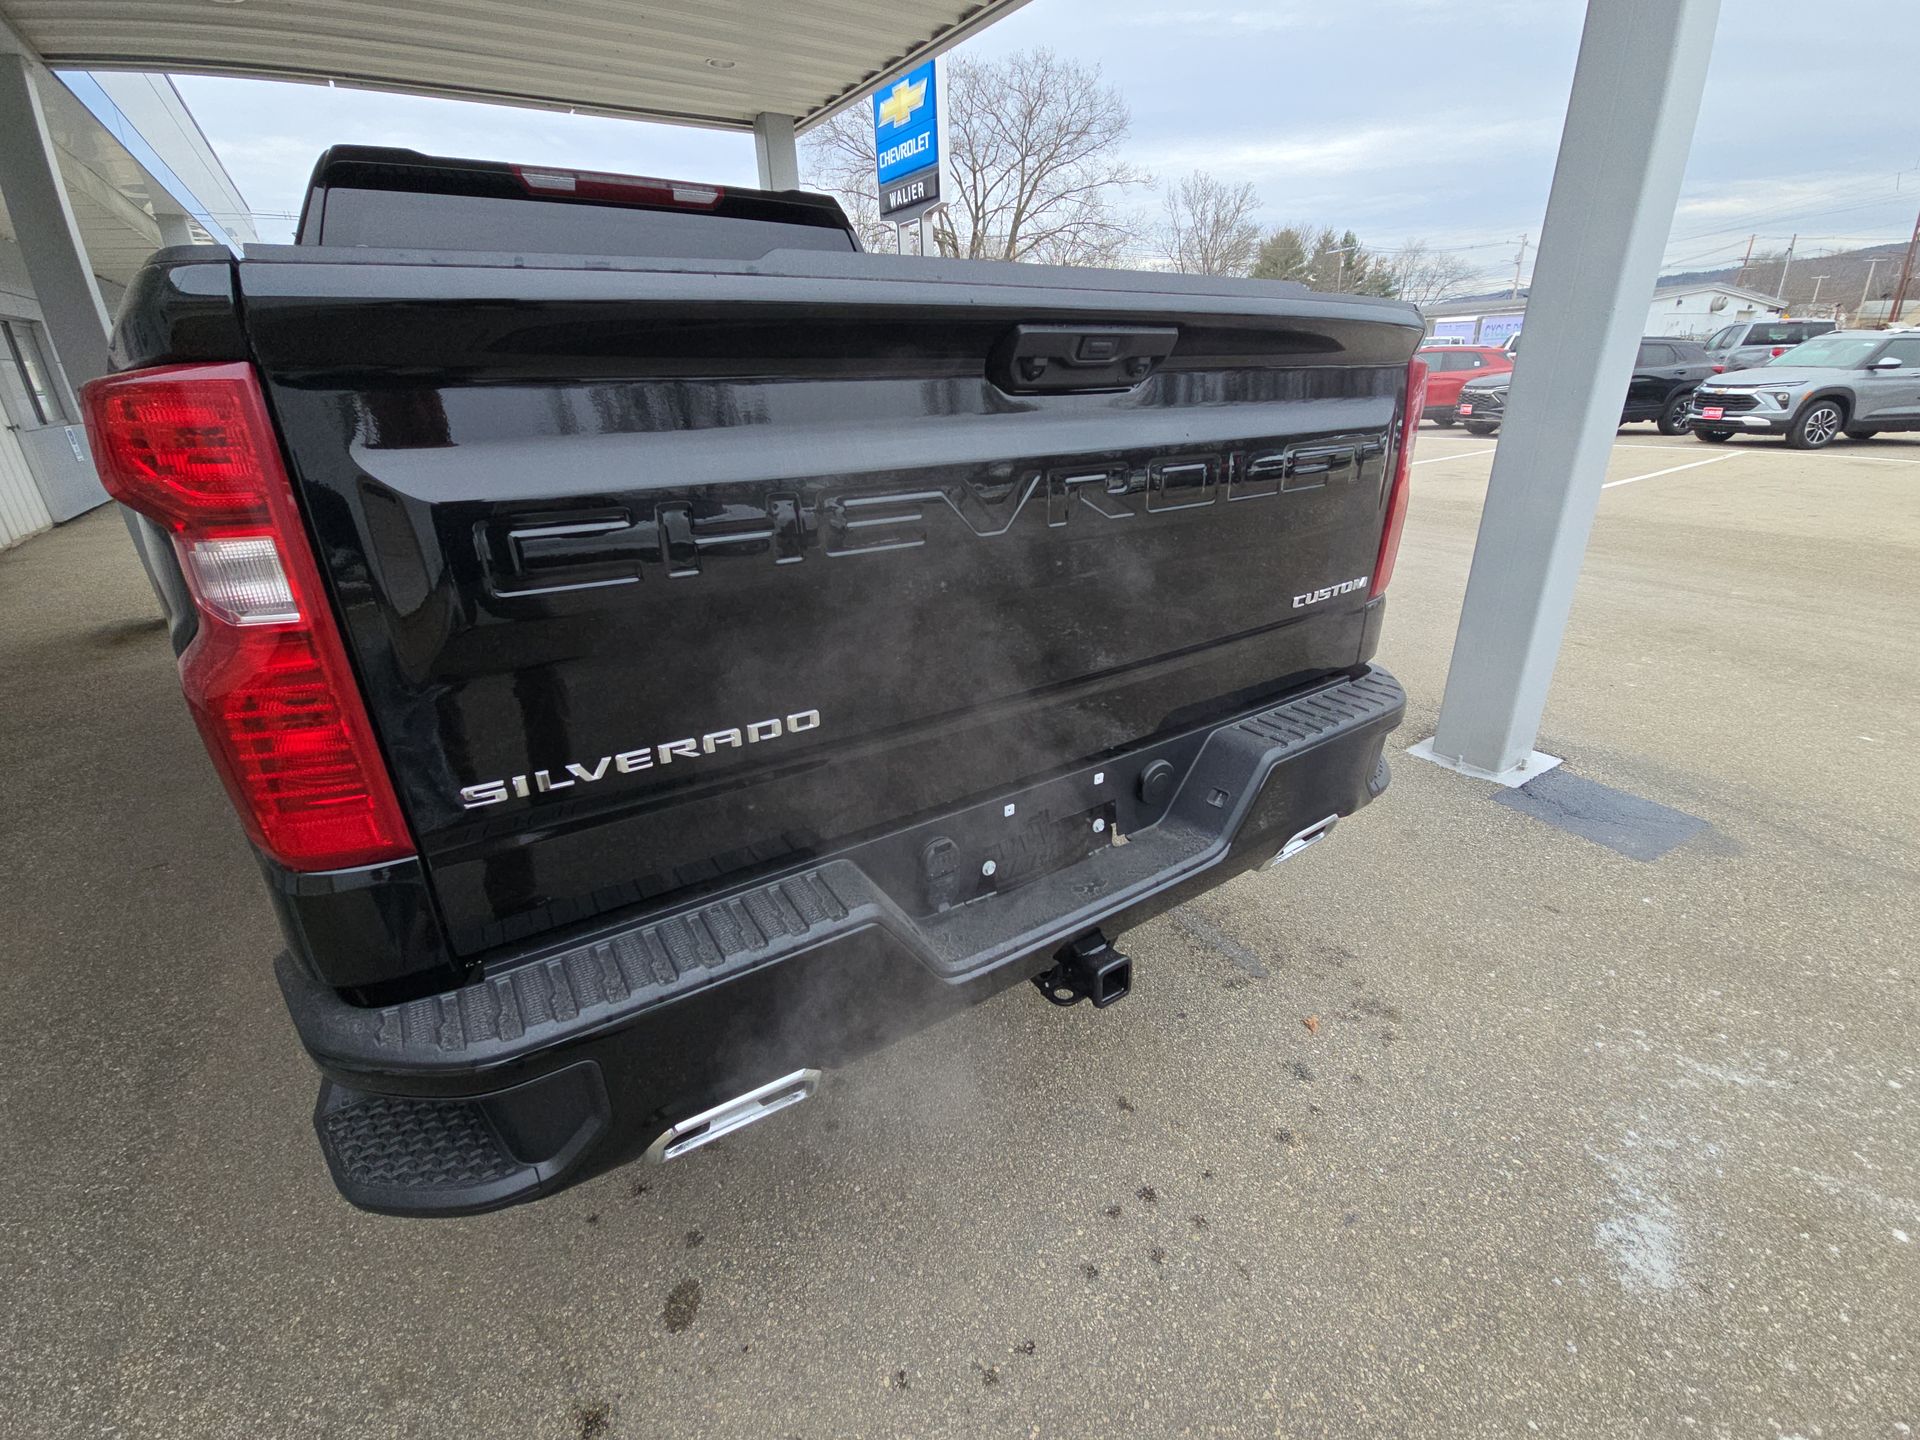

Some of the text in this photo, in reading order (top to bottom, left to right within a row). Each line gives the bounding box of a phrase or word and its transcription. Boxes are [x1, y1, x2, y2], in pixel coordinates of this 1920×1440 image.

[879, 131, 931, 168] CHEVROLET
[472, 433, 1382, 598] CHEVROLET
[1292, 576, 1368, 608] CUSTOM
[460, 709, 820, 809] SILVERADO
